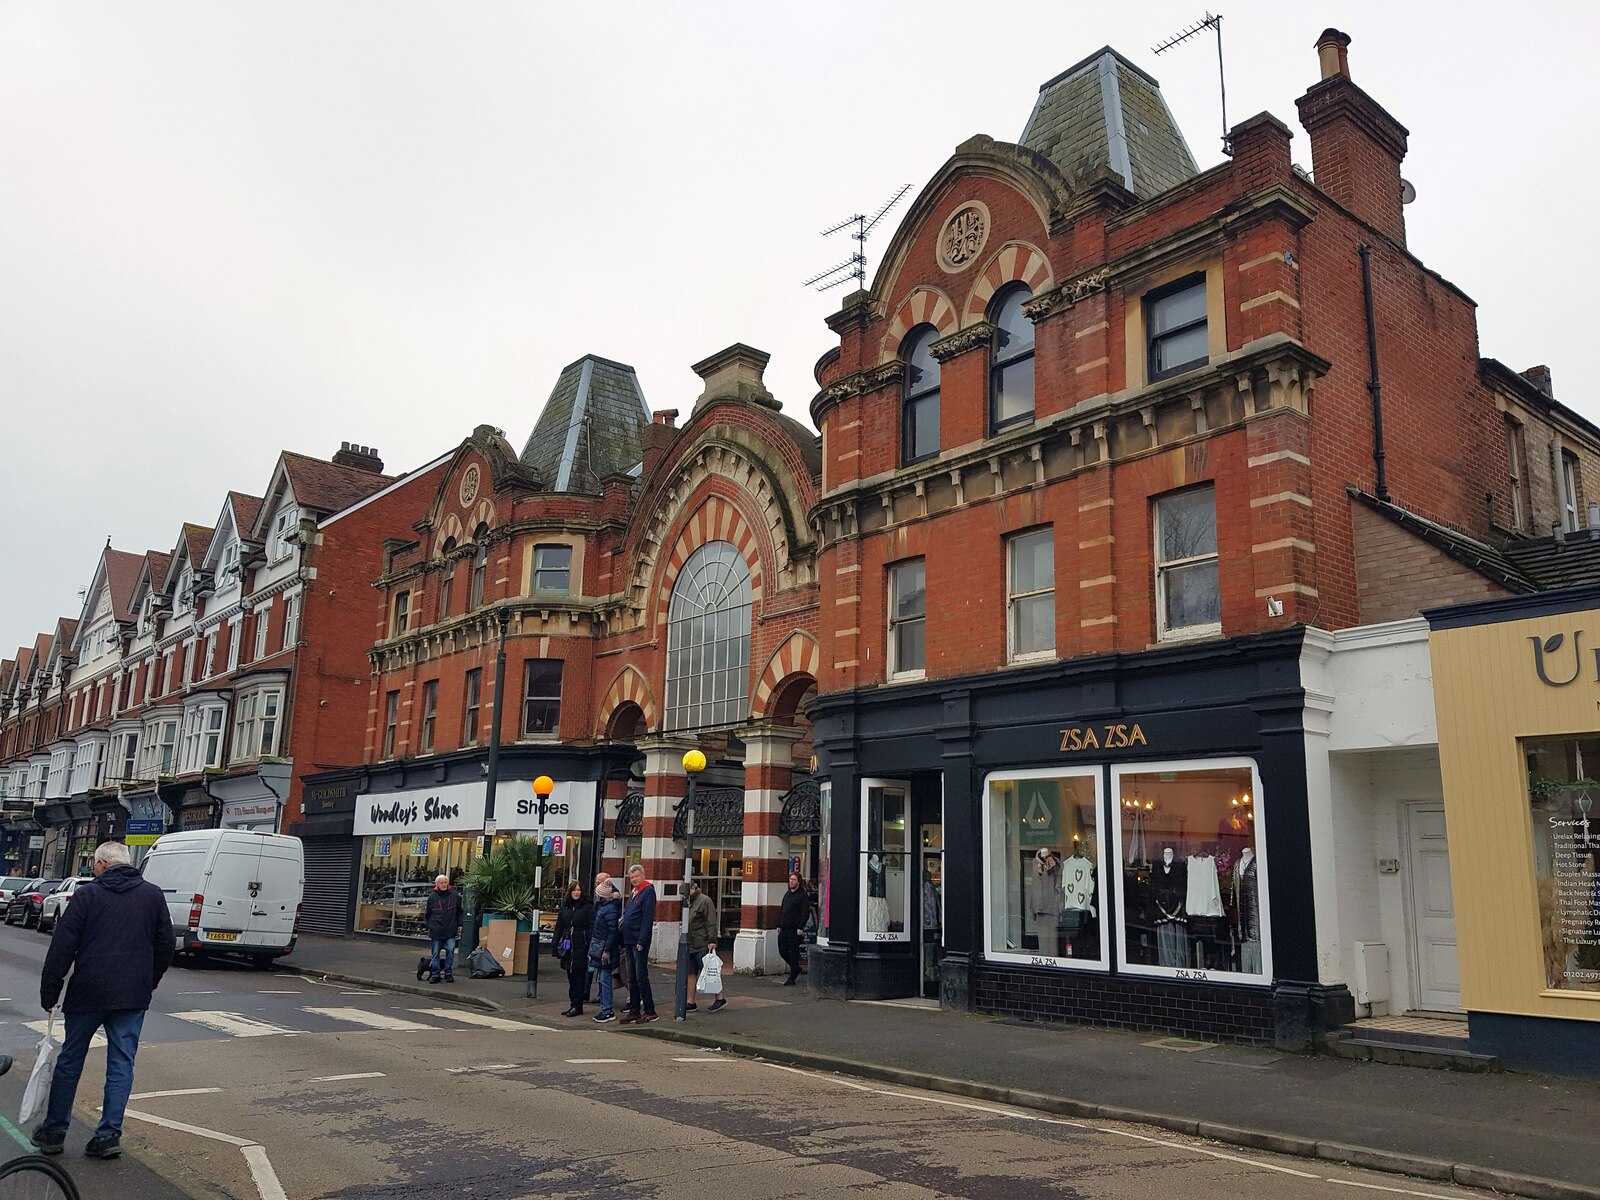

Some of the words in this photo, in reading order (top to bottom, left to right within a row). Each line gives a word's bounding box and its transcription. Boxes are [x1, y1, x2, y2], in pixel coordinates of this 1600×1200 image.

[1060, 728, 1099, 751] ZSA
[1104, 723, 1147, 748] ZSA
[370, 801, 418, 826] Woodley's
[424, 796, 459, 822] Shoes
[1549, 816, 1591, 828] Services
[1555, 851, 1571, 859] Deep
[1571, 851, 1592, 859] Tissue
[874, 933, 887, 941] ZSA
[888, 933, 899, 941] ZSA
[1562, 928, 1592, 936] Signature
[1576, 938, 1597, 946] Luxury
[1031, 956, 1043, 965] ZSA
[1045, 958, 1058, 967] ZSA
[1175, 969, 1190, 979] ZSA
[1193, 971, 1208, 980] ZSA
